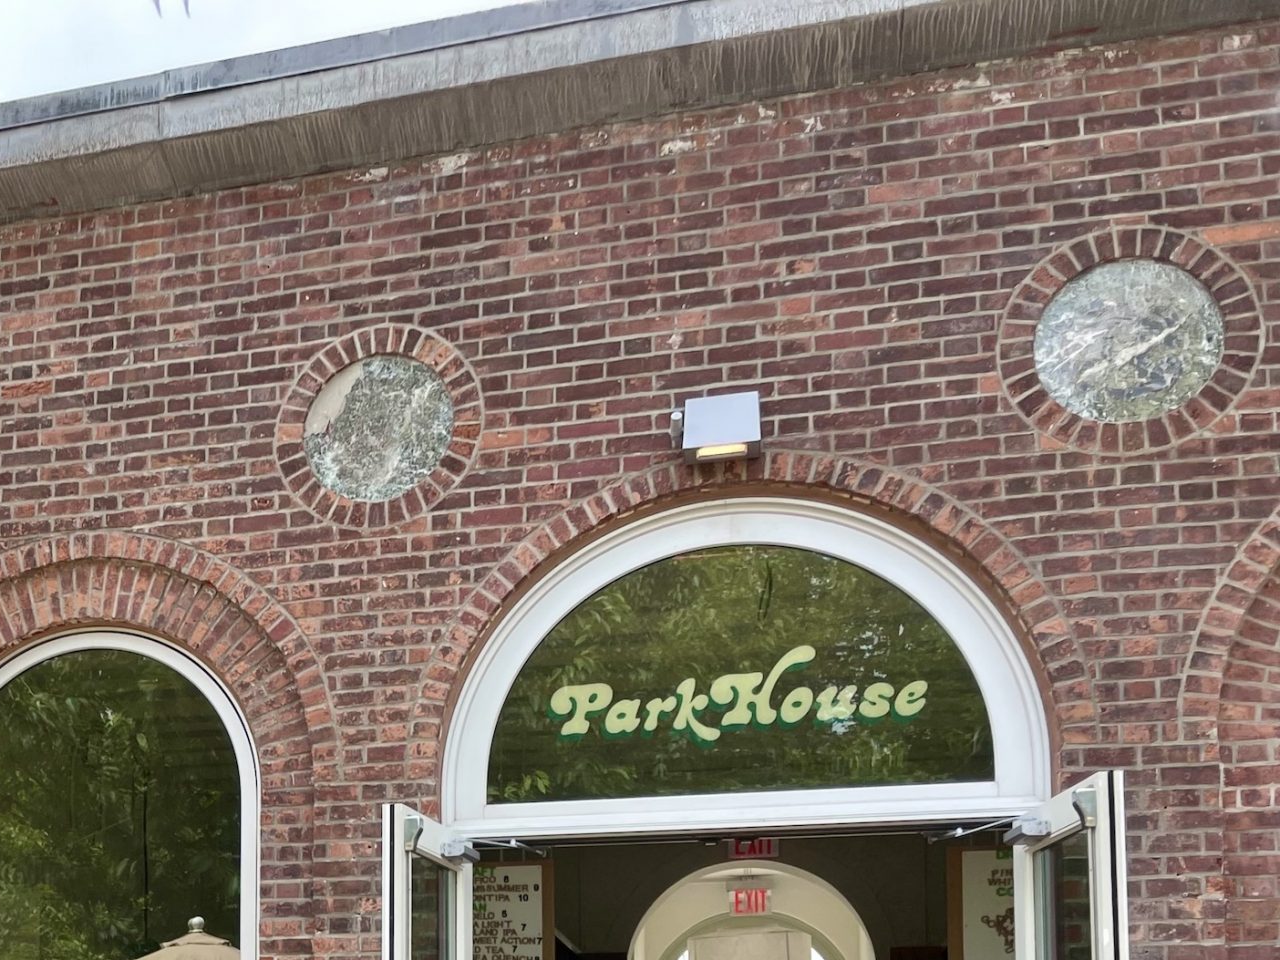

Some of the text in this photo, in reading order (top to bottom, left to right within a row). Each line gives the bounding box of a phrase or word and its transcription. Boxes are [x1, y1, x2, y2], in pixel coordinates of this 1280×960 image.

[549, 645, 928, 745] ParkHouse
[518, 893, 529, 902] 10
[735, 888, 766, 913] EXIT
[503, 928, 517, 936] IPA
[485, 946, 504, 954] TEA
[512, 945, 518, 953] 7
